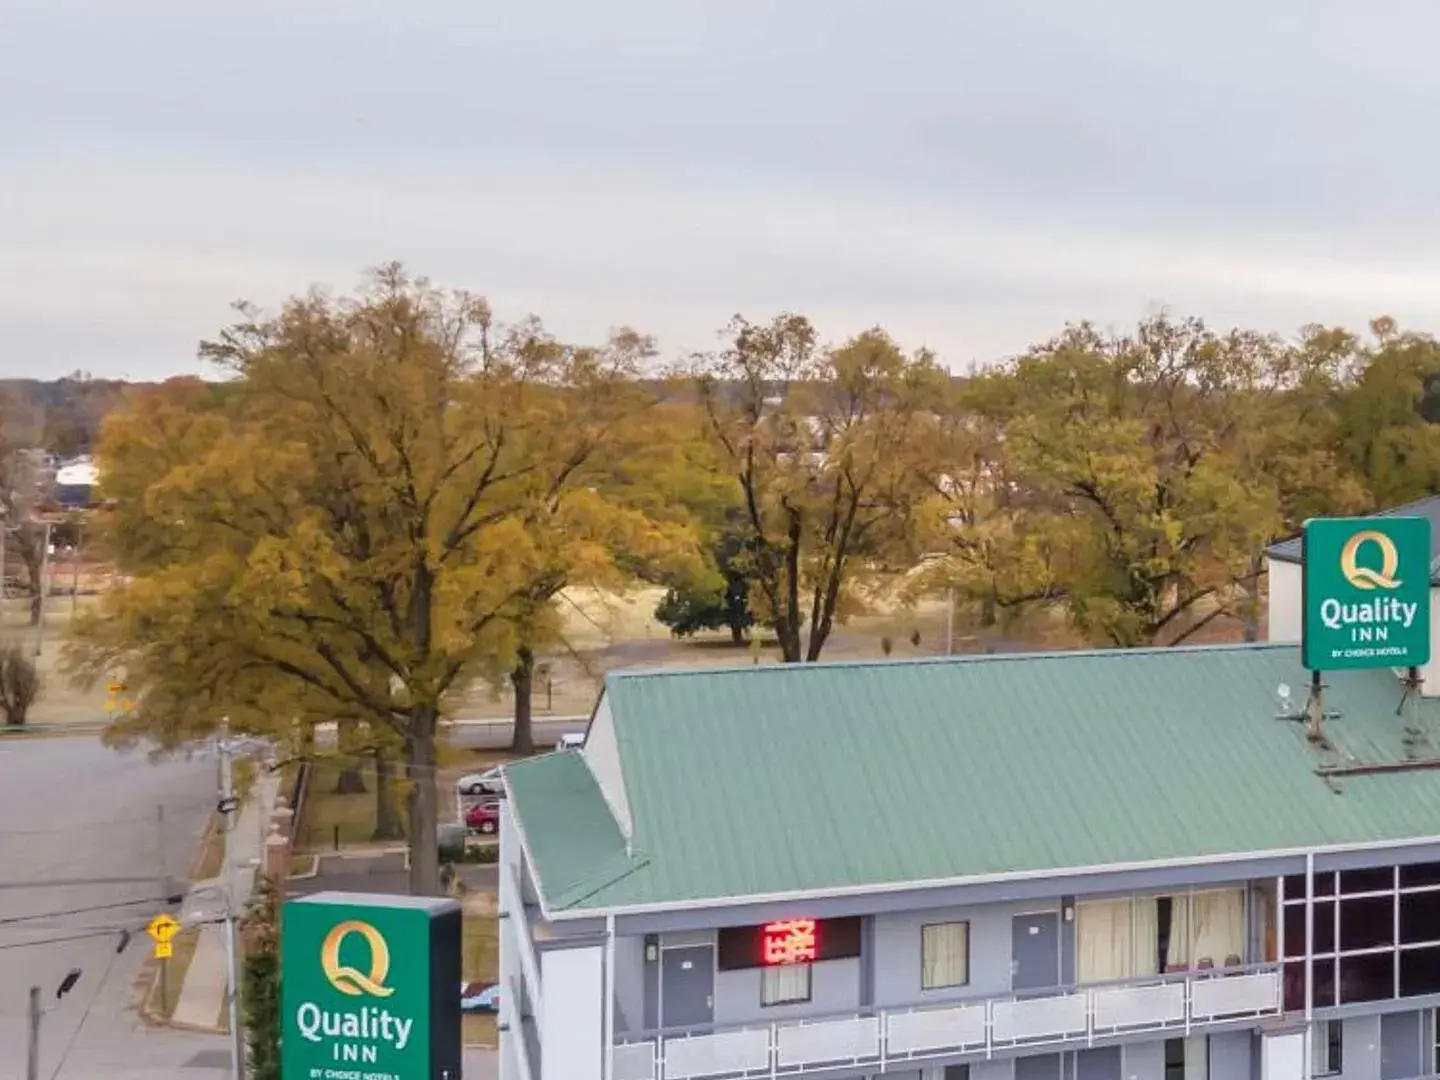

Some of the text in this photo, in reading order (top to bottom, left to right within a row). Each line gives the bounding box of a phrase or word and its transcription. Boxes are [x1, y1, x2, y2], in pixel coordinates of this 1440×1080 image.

[1340, 530, 1403, 590] Q
[1320, 597, 1417, 630] Quality
[1351, 626, 1389, 642] INN
[320, 920, 395, 997] Q
[296, 1002, 413, 1050] Quality
[333, 1042, 377, 1063] INN
[310, 1068, 322, 1079] BY
[324, 1069, 362, 1080] CHOICE
